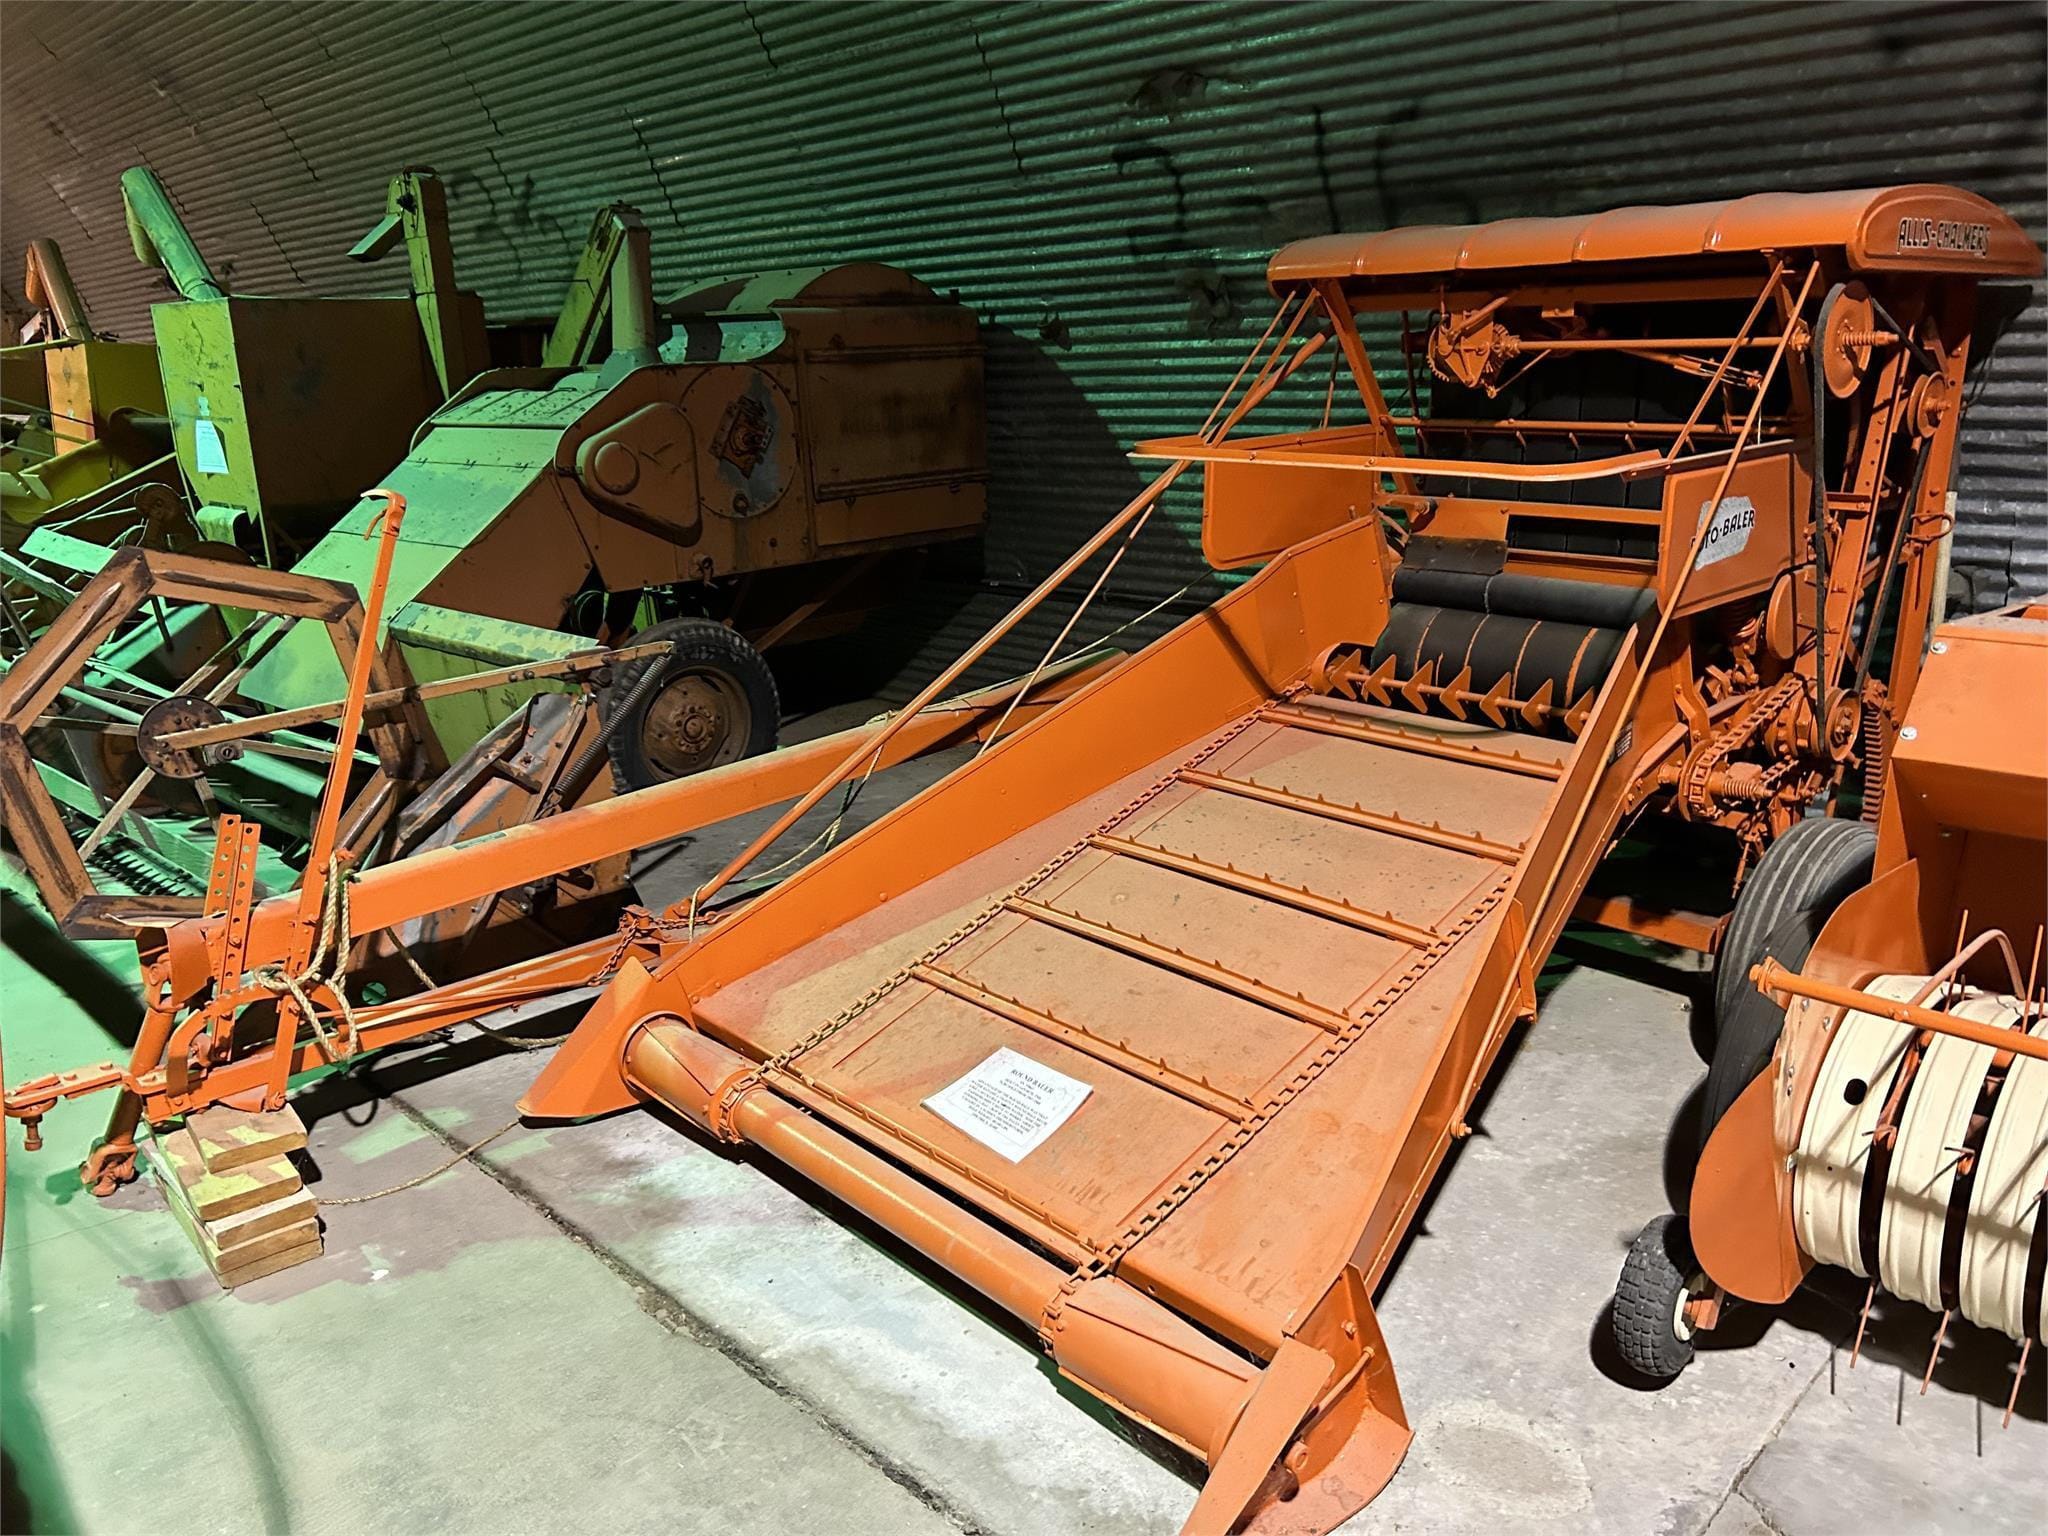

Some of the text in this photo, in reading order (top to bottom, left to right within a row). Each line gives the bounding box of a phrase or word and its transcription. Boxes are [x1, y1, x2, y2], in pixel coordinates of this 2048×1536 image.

[1897, 217, 1990, 258] ALLIS-CHALMERS
[1690, 508, 1756, 553] TO-BALER
[1011, 1069, 1034, 1083] ROUND
